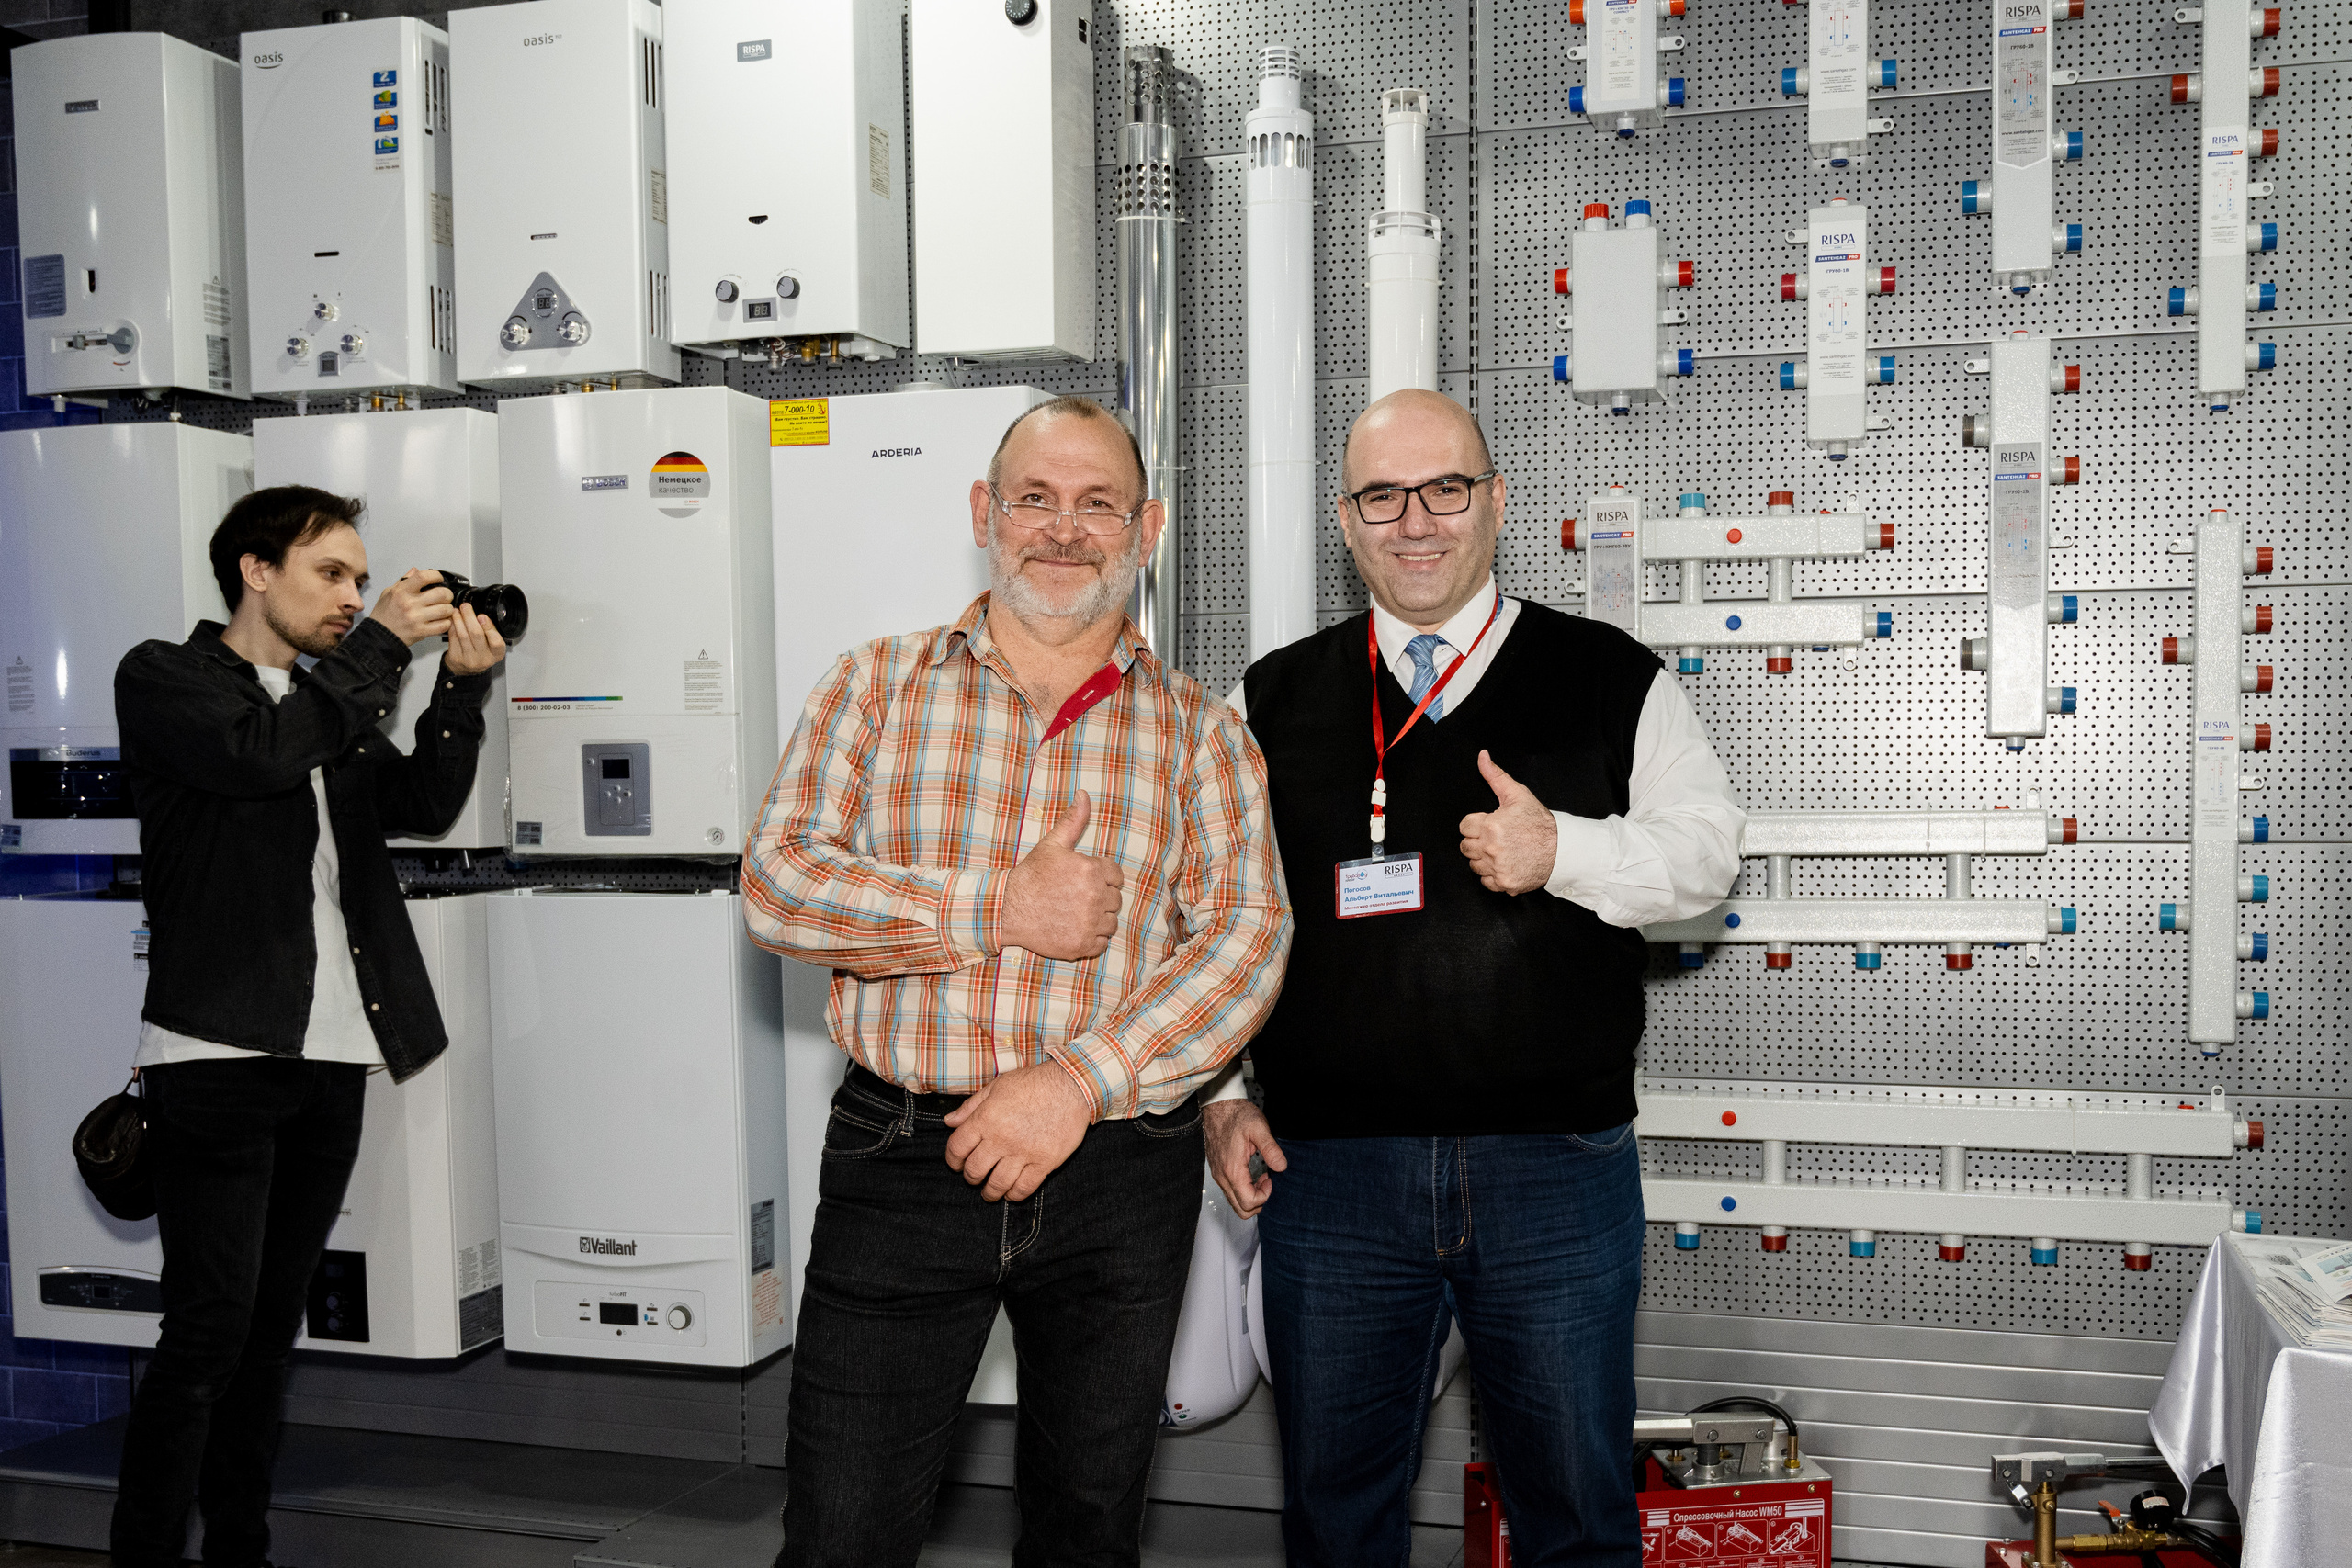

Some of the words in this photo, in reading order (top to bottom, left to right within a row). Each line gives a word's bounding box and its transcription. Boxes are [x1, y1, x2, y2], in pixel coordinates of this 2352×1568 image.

[2005, 5, 2041, 17] RISPA
[524, 32, 554, 47] oasis
[742, 43, 766, 55] RISPA
[254, 51, 284, 64] oasis
[2211, 135, 2239, 144] RISPA
[1821, 233, 1856, 245] RISPA
[784, 404, 815, 414] 7-000-10
[871, 446, 923, 459] ARDERIA
[2000, 451, 2036, 462] RISPA
[658, 476, 702, 484] Немецкое
[1596, 511, 1629, 522] RISPA
[2203, 721, 2230, 729] RISPA
[1385, 863, 1413, 874] RISPA
[1344, 886, 1371, 894] Погосов
[1374, 889, 1414, 899] Витальевич
[591, 1237, 638, 1256] Vaillant
[1673, 1509, 1735, 1524] Опрессовочный
[1735, 1508, 1758, 1518] Насос
[1758, 1506, 1783, 1517] WM50
